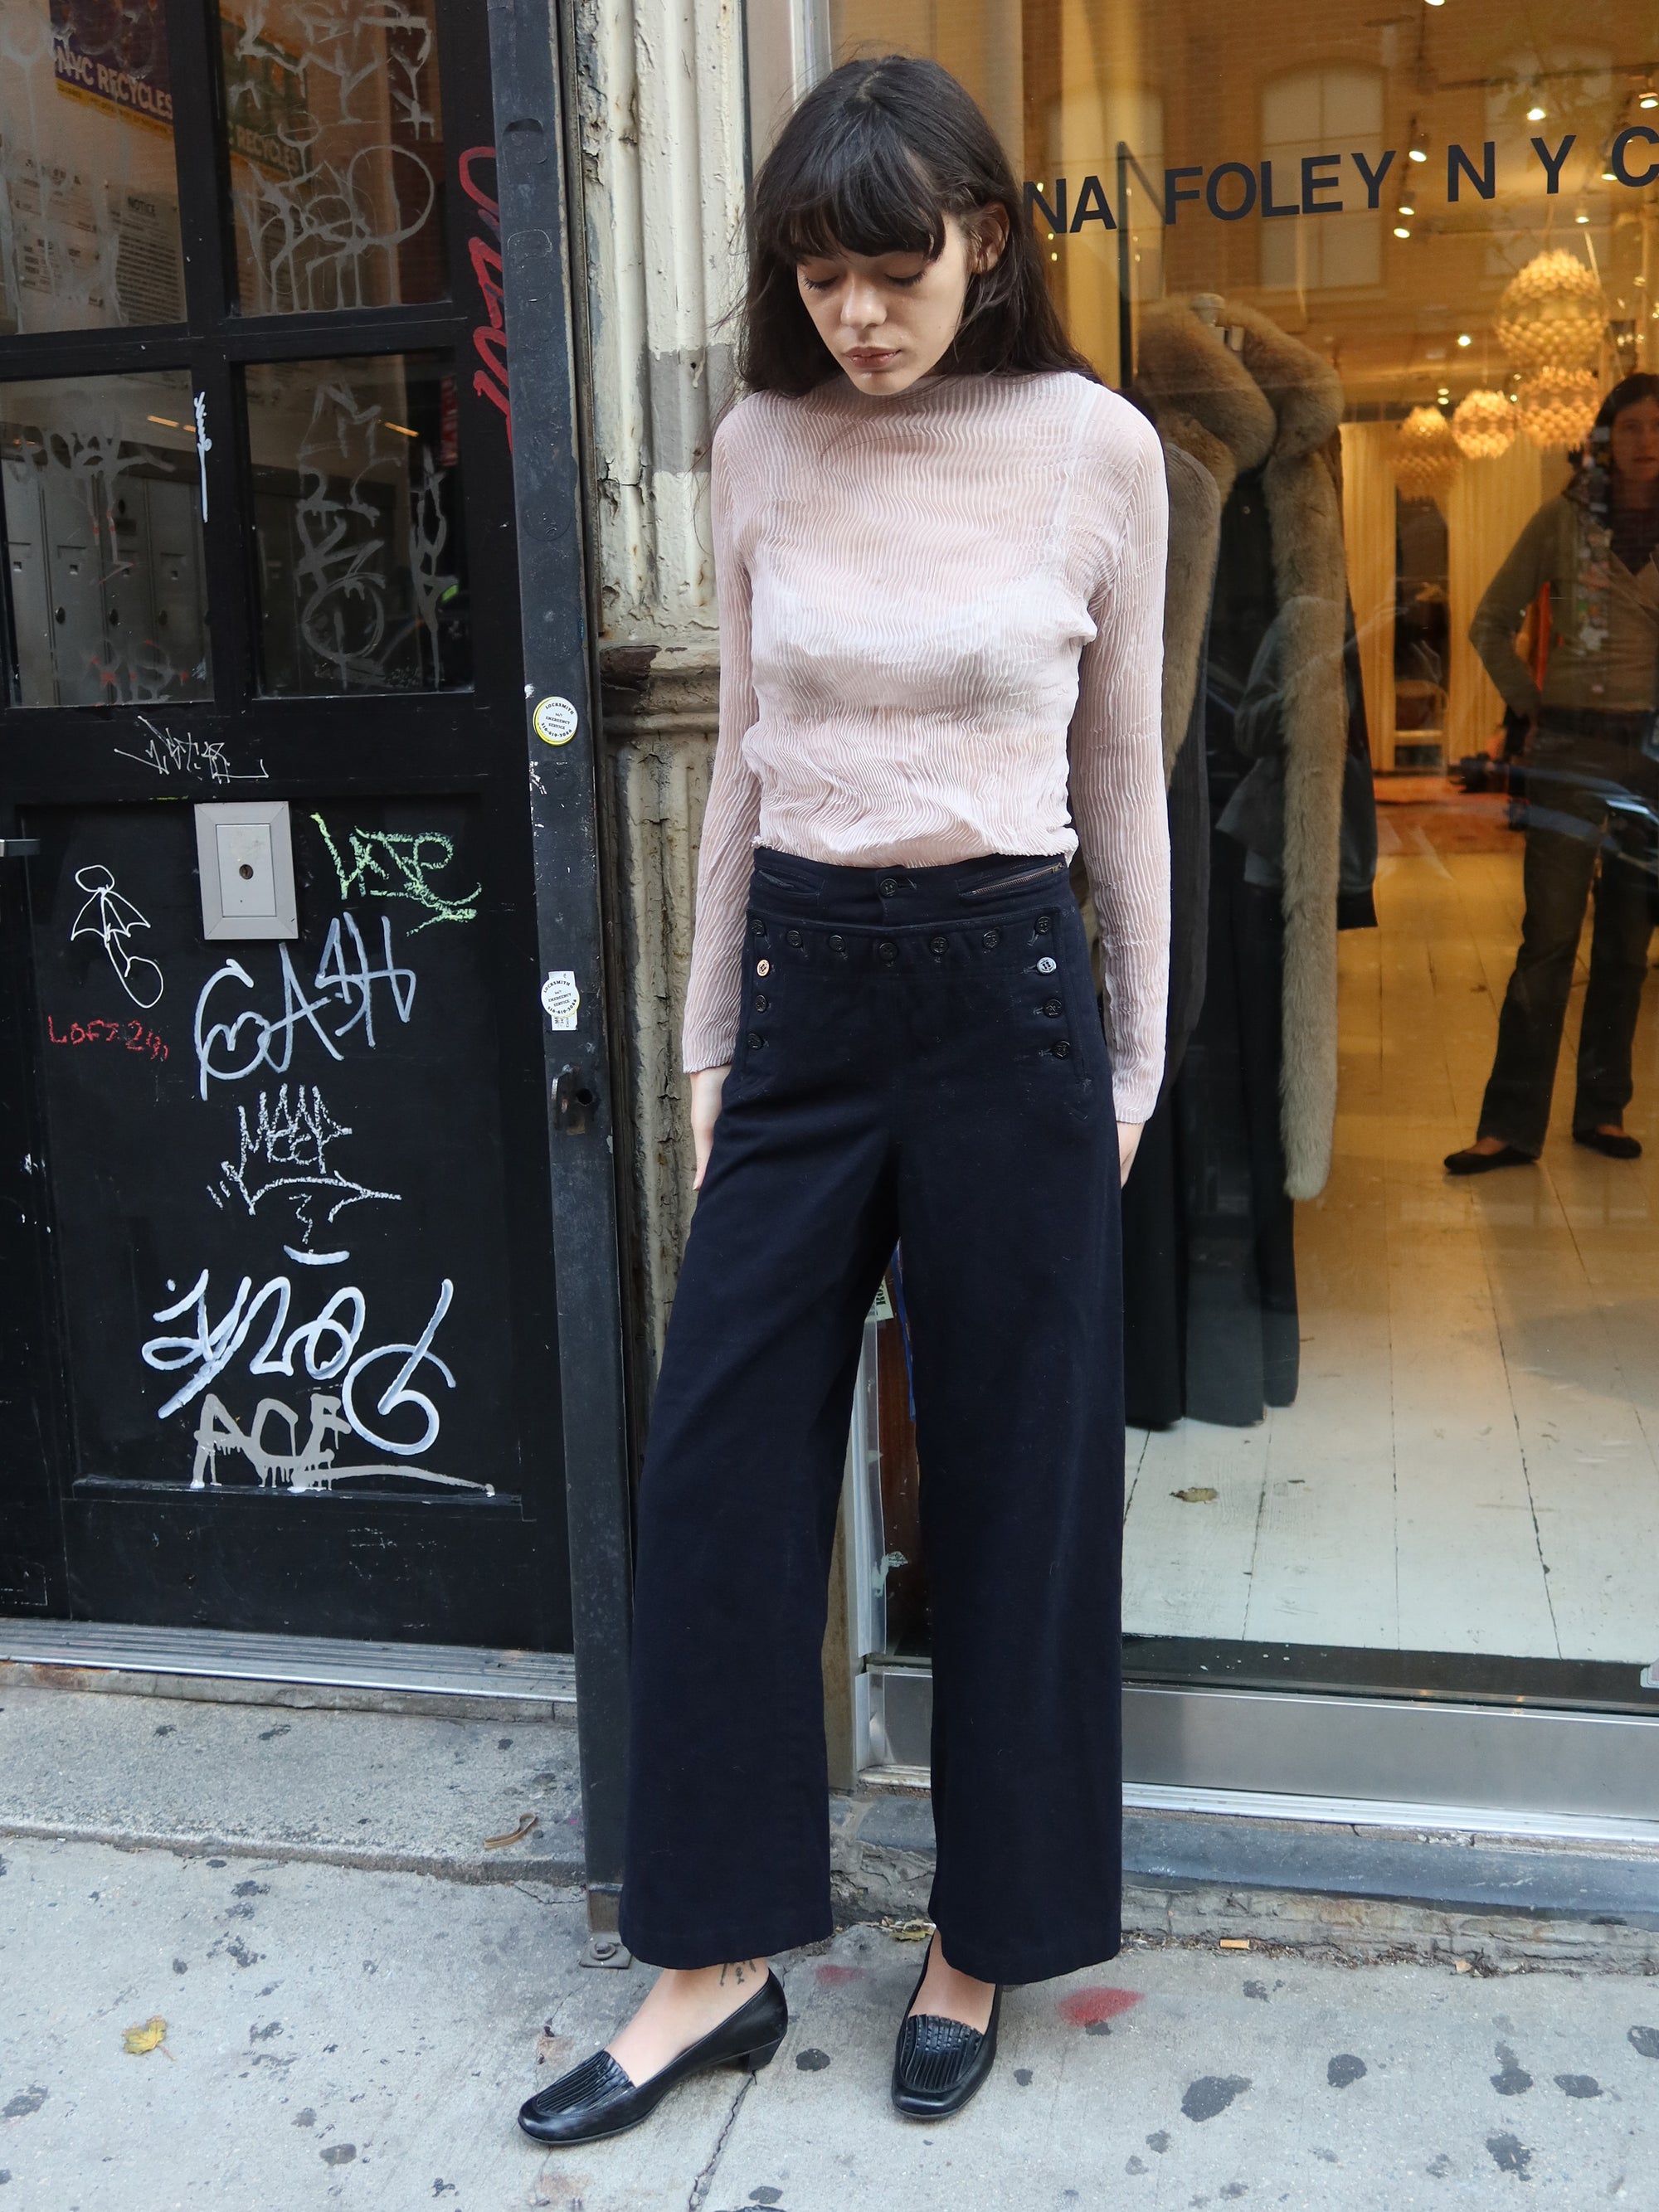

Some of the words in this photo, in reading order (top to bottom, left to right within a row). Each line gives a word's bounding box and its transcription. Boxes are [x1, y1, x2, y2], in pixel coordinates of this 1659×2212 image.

[56, 45, 95, 85] NYC
[96, 62, 173, 120] RECYCLES
[1165, 150, 1397, 225] FOLEY
[545, 702, 574, 715] LOCKSMITH
[545, 716, 571, 725] EMERGENCY
[543, 980, 571, 994] LOCKSMITH
[548, 993, 572, 1003] EMERGENCY
